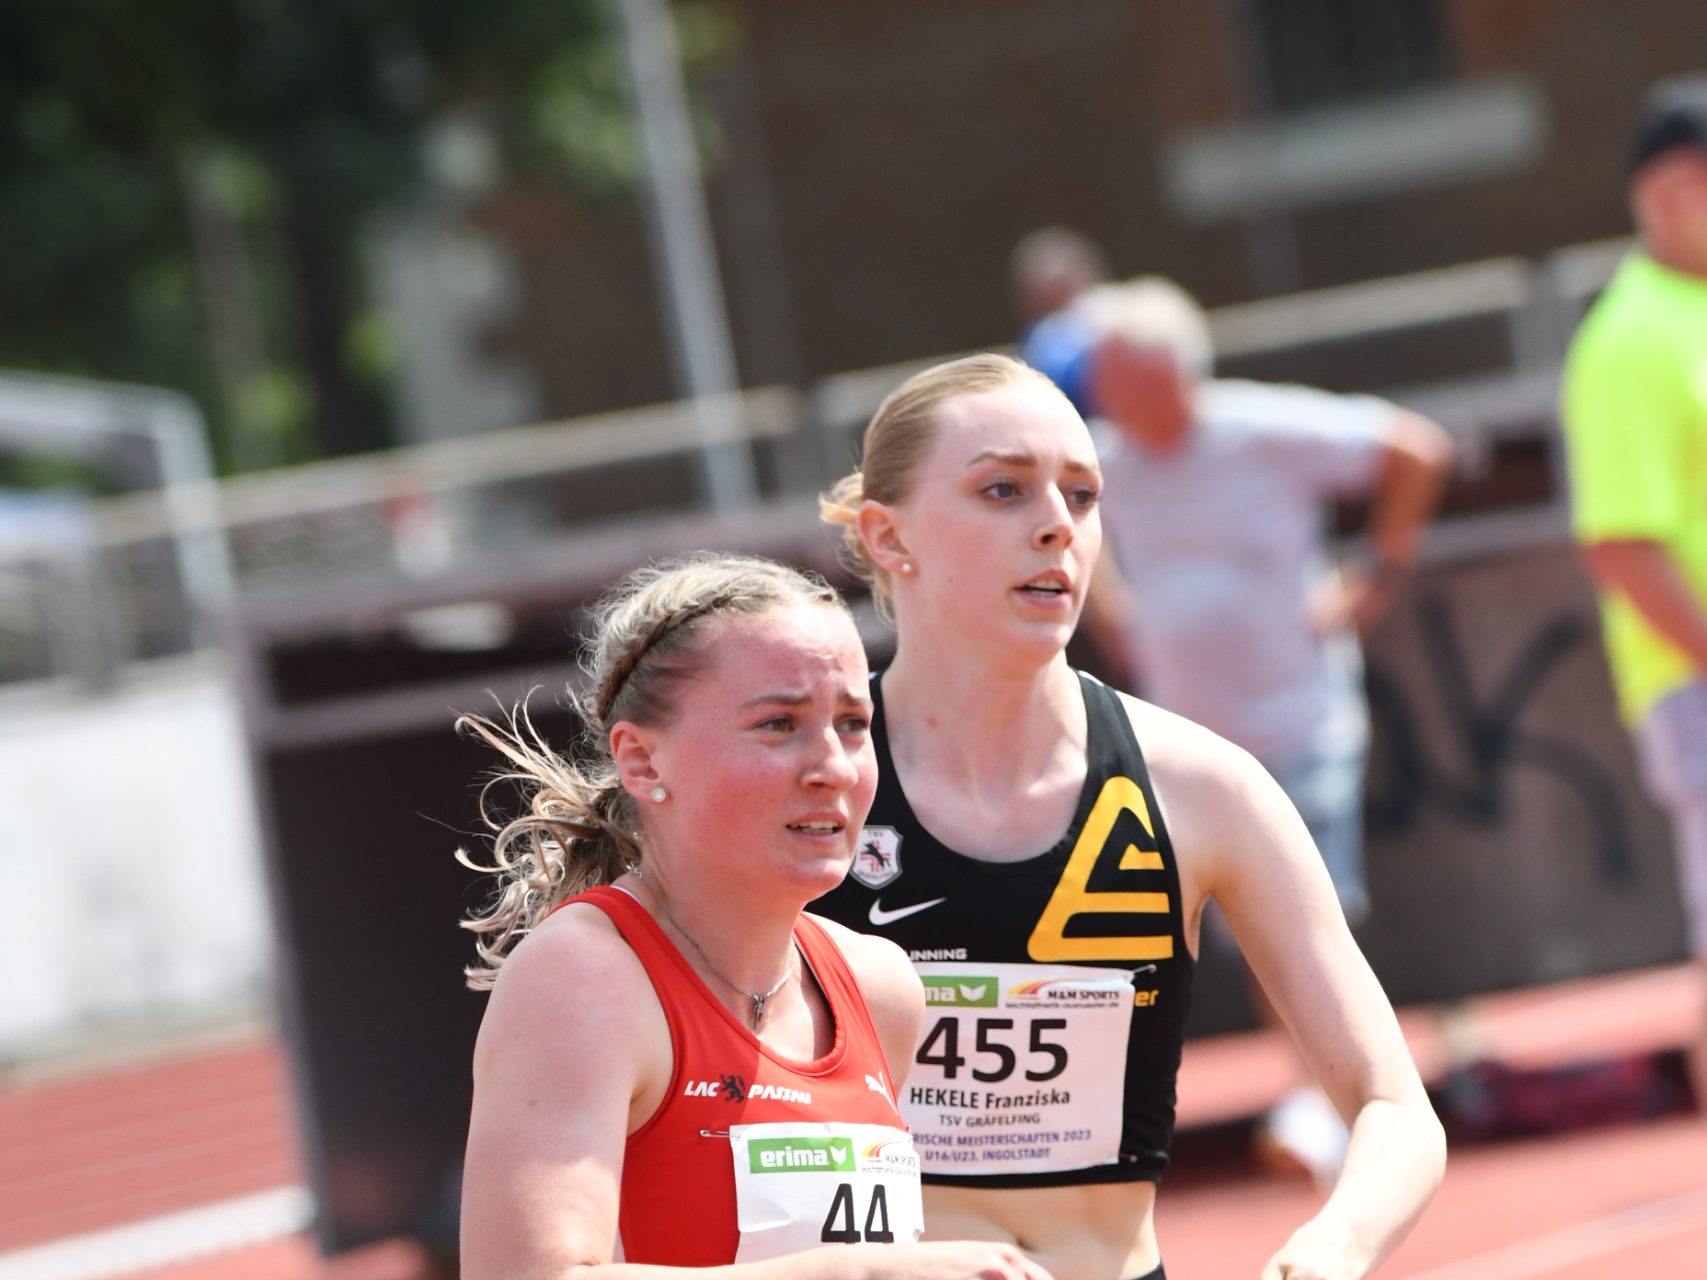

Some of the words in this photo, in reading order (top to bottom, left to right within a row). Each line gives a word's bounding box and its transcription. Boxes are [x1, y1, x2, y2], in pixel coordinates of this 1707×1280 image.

[1048, 990, 1077, 1000] M&M
[1080, 990, 1119, 1000] SPORTS
[915, 1016, 1069, 1083] 455
[684, 1080, 720, 1097] LAC
[910, 1087, 980, 1109] HEKELE
[985, 1088, 1071, 1109] Franziska
[939, 1114, 962, 1126] TSV
[966, 1112, 1041, 1127] GRÄFELFING
[956, 1131, 1060, 1147] MEISTERSCHAFTEN
[1063, 1129, 1091, 1142] 2023
[760, 1145, 830, 1168] erima
[982, 1148, 1052, 1162] INGOLSTADT
[820, 1183, 895, 1244] 44
